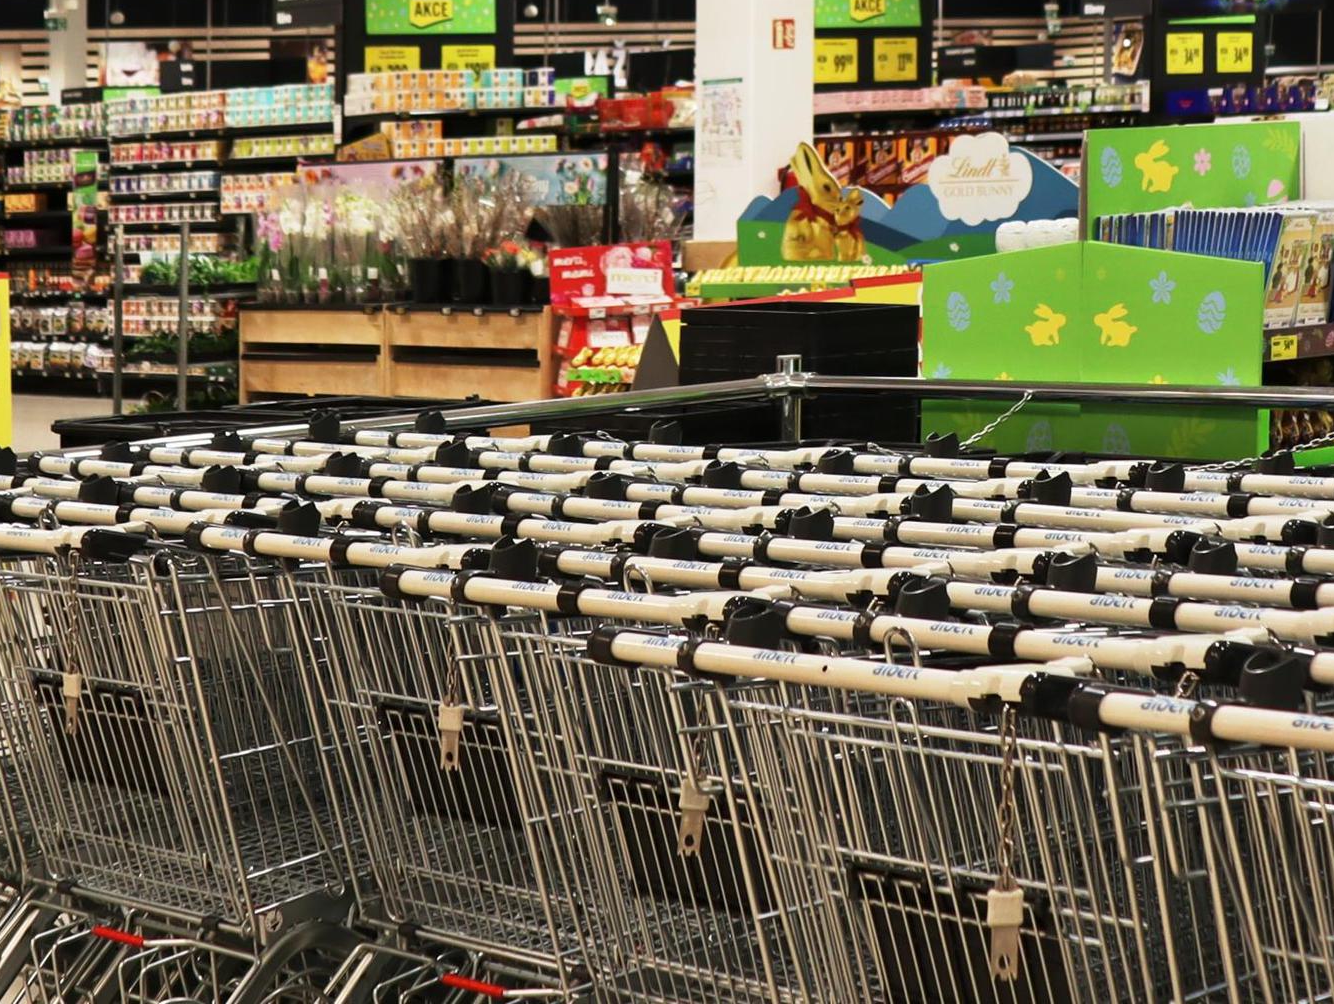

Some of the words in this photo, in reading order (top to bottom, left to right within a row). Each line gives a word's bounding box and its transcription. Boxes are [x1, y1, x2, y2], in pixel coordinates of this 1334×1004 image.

[414, 2, 449, 17] AKCE
[950, 156, 998, 178] Lindt
[873, 665, 922, 680] albert
